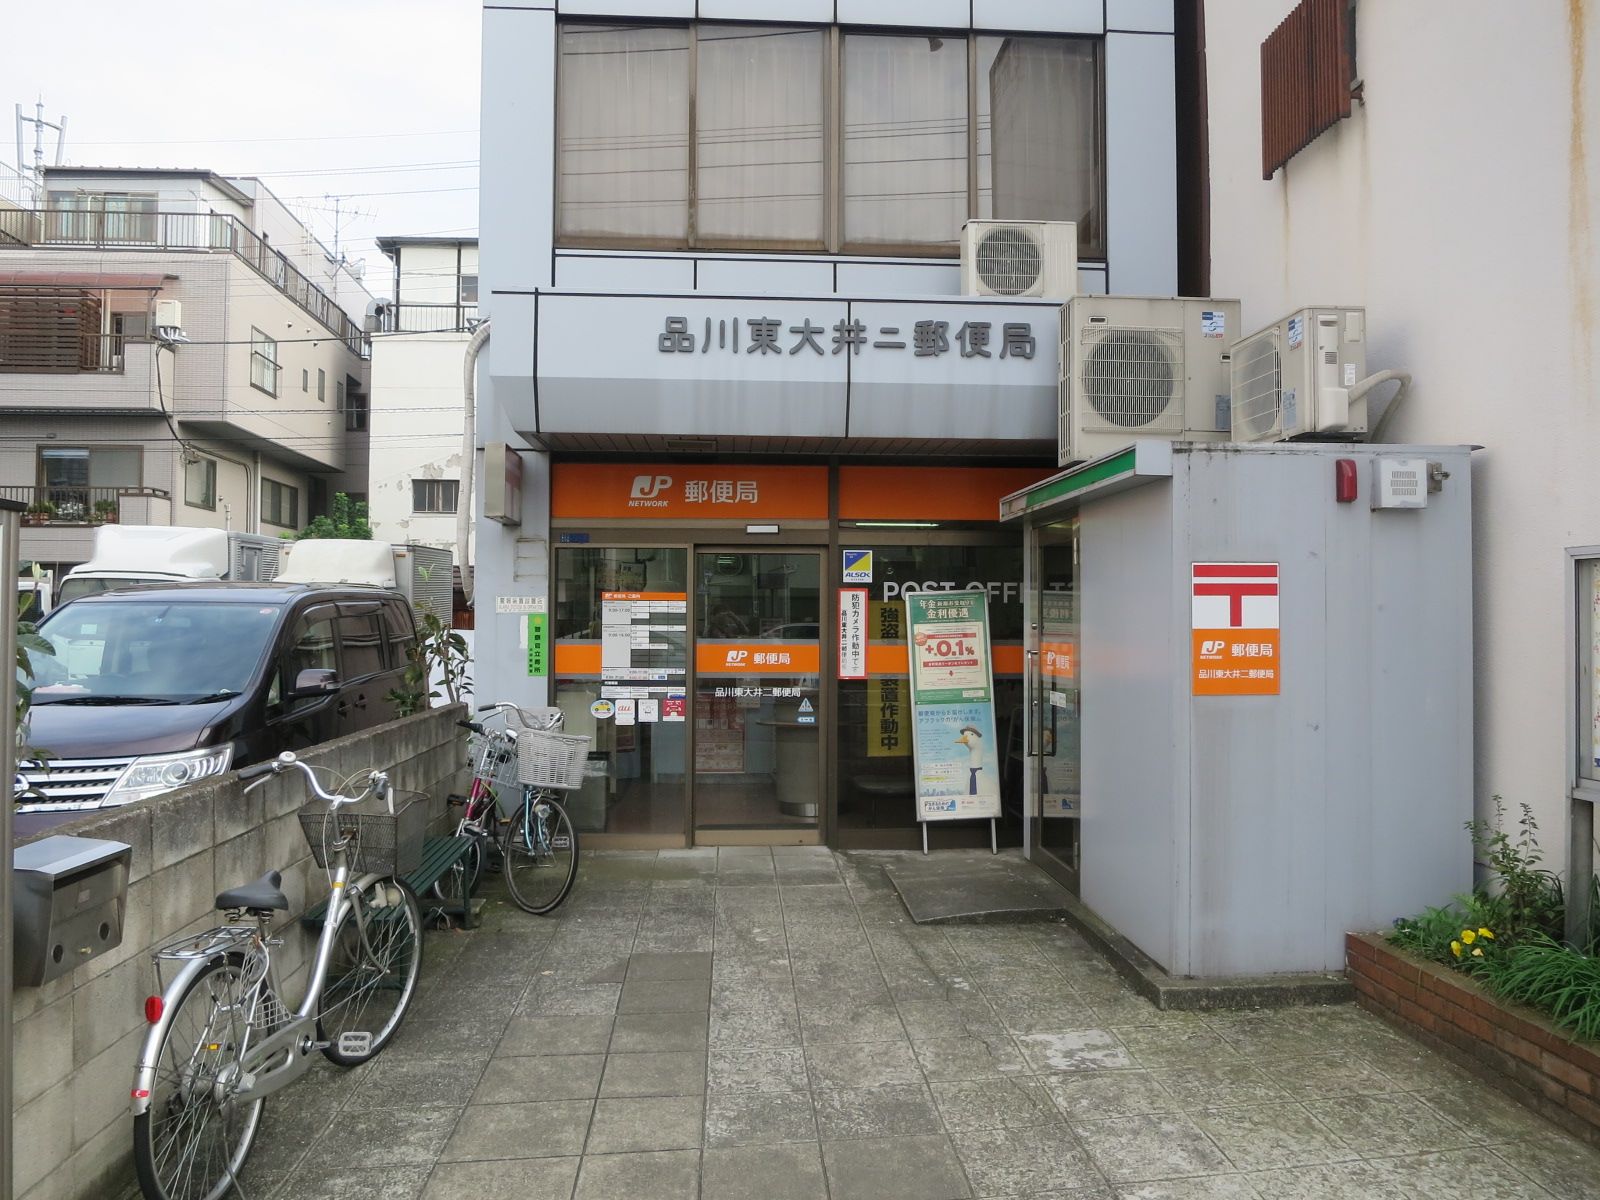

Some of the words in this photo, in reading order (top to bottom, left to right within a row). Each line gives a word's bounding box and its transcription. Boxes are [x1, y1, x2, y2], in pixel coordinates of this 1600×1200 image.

[658, 316, 1036, 359] 品川東大井二郵便局
[630, 475, 673, 498] JP
[684, 480, 758, 504] 郵便局
[927, 608, 969, 619] 金利優遇
[851, 593, 861, 673] 防犯カメラ作動中です
[1200, 641, 1225, 655] JP
[1231, 643, 1273, 657] 郵便局
[726, 650, 748, 662] JP
[753, 653, 791, 665] 郵便局
[1198, 669, 1275, 679] 品川東大井二郵便局
[714, 687, 801, 698] 品川東大井二郵便局
